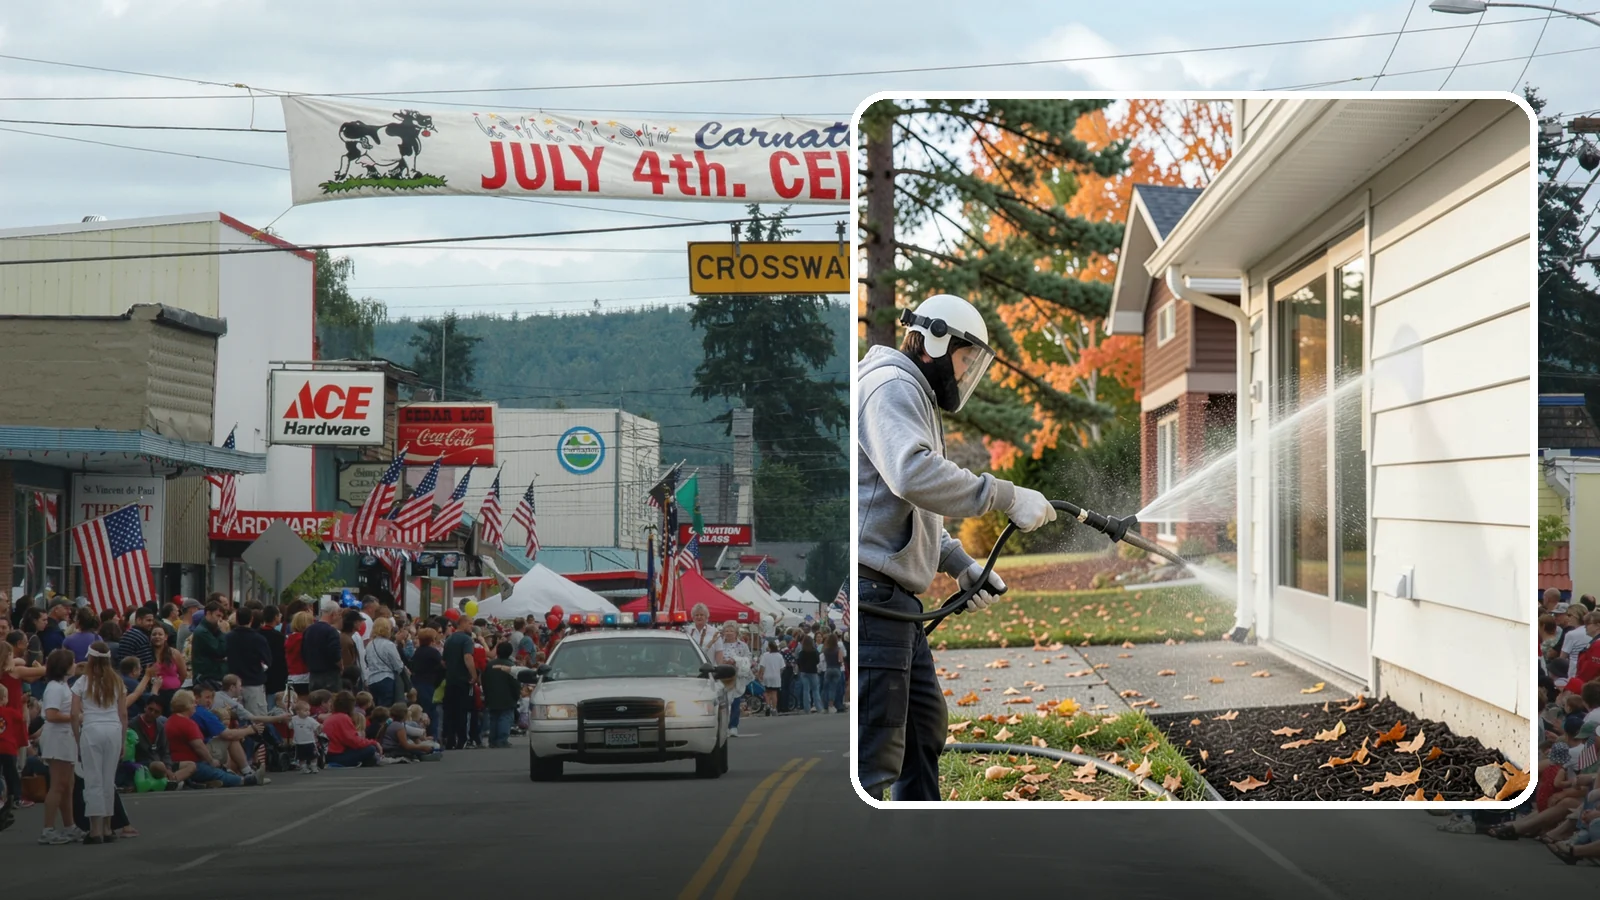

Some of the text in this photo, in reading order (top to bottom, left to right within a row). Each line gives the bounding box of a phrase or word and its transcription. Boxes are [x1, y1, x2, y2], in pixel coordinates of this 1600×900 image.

[695, 121, 850, 149] Carnat
[481, 141, 605, 192] JULY
[632, 150, 746, 197] 4th.
[697, 254, 850, 280] CROSSWA
[282, 380, 373, 420] ACE
[406, 409, 485, 421] CEDAR LOG
[283, 421, 371, 437] Hardware
[416, 427, 477, 447] Coca-Cola
[95, 485, 124, 494] Vincent
[126, 486, 136, 494] de
[137, 486, 155, 495] Paul
[688, 527, 741, 535] CRNATION
[699, 535, 730, 543] GLASS
